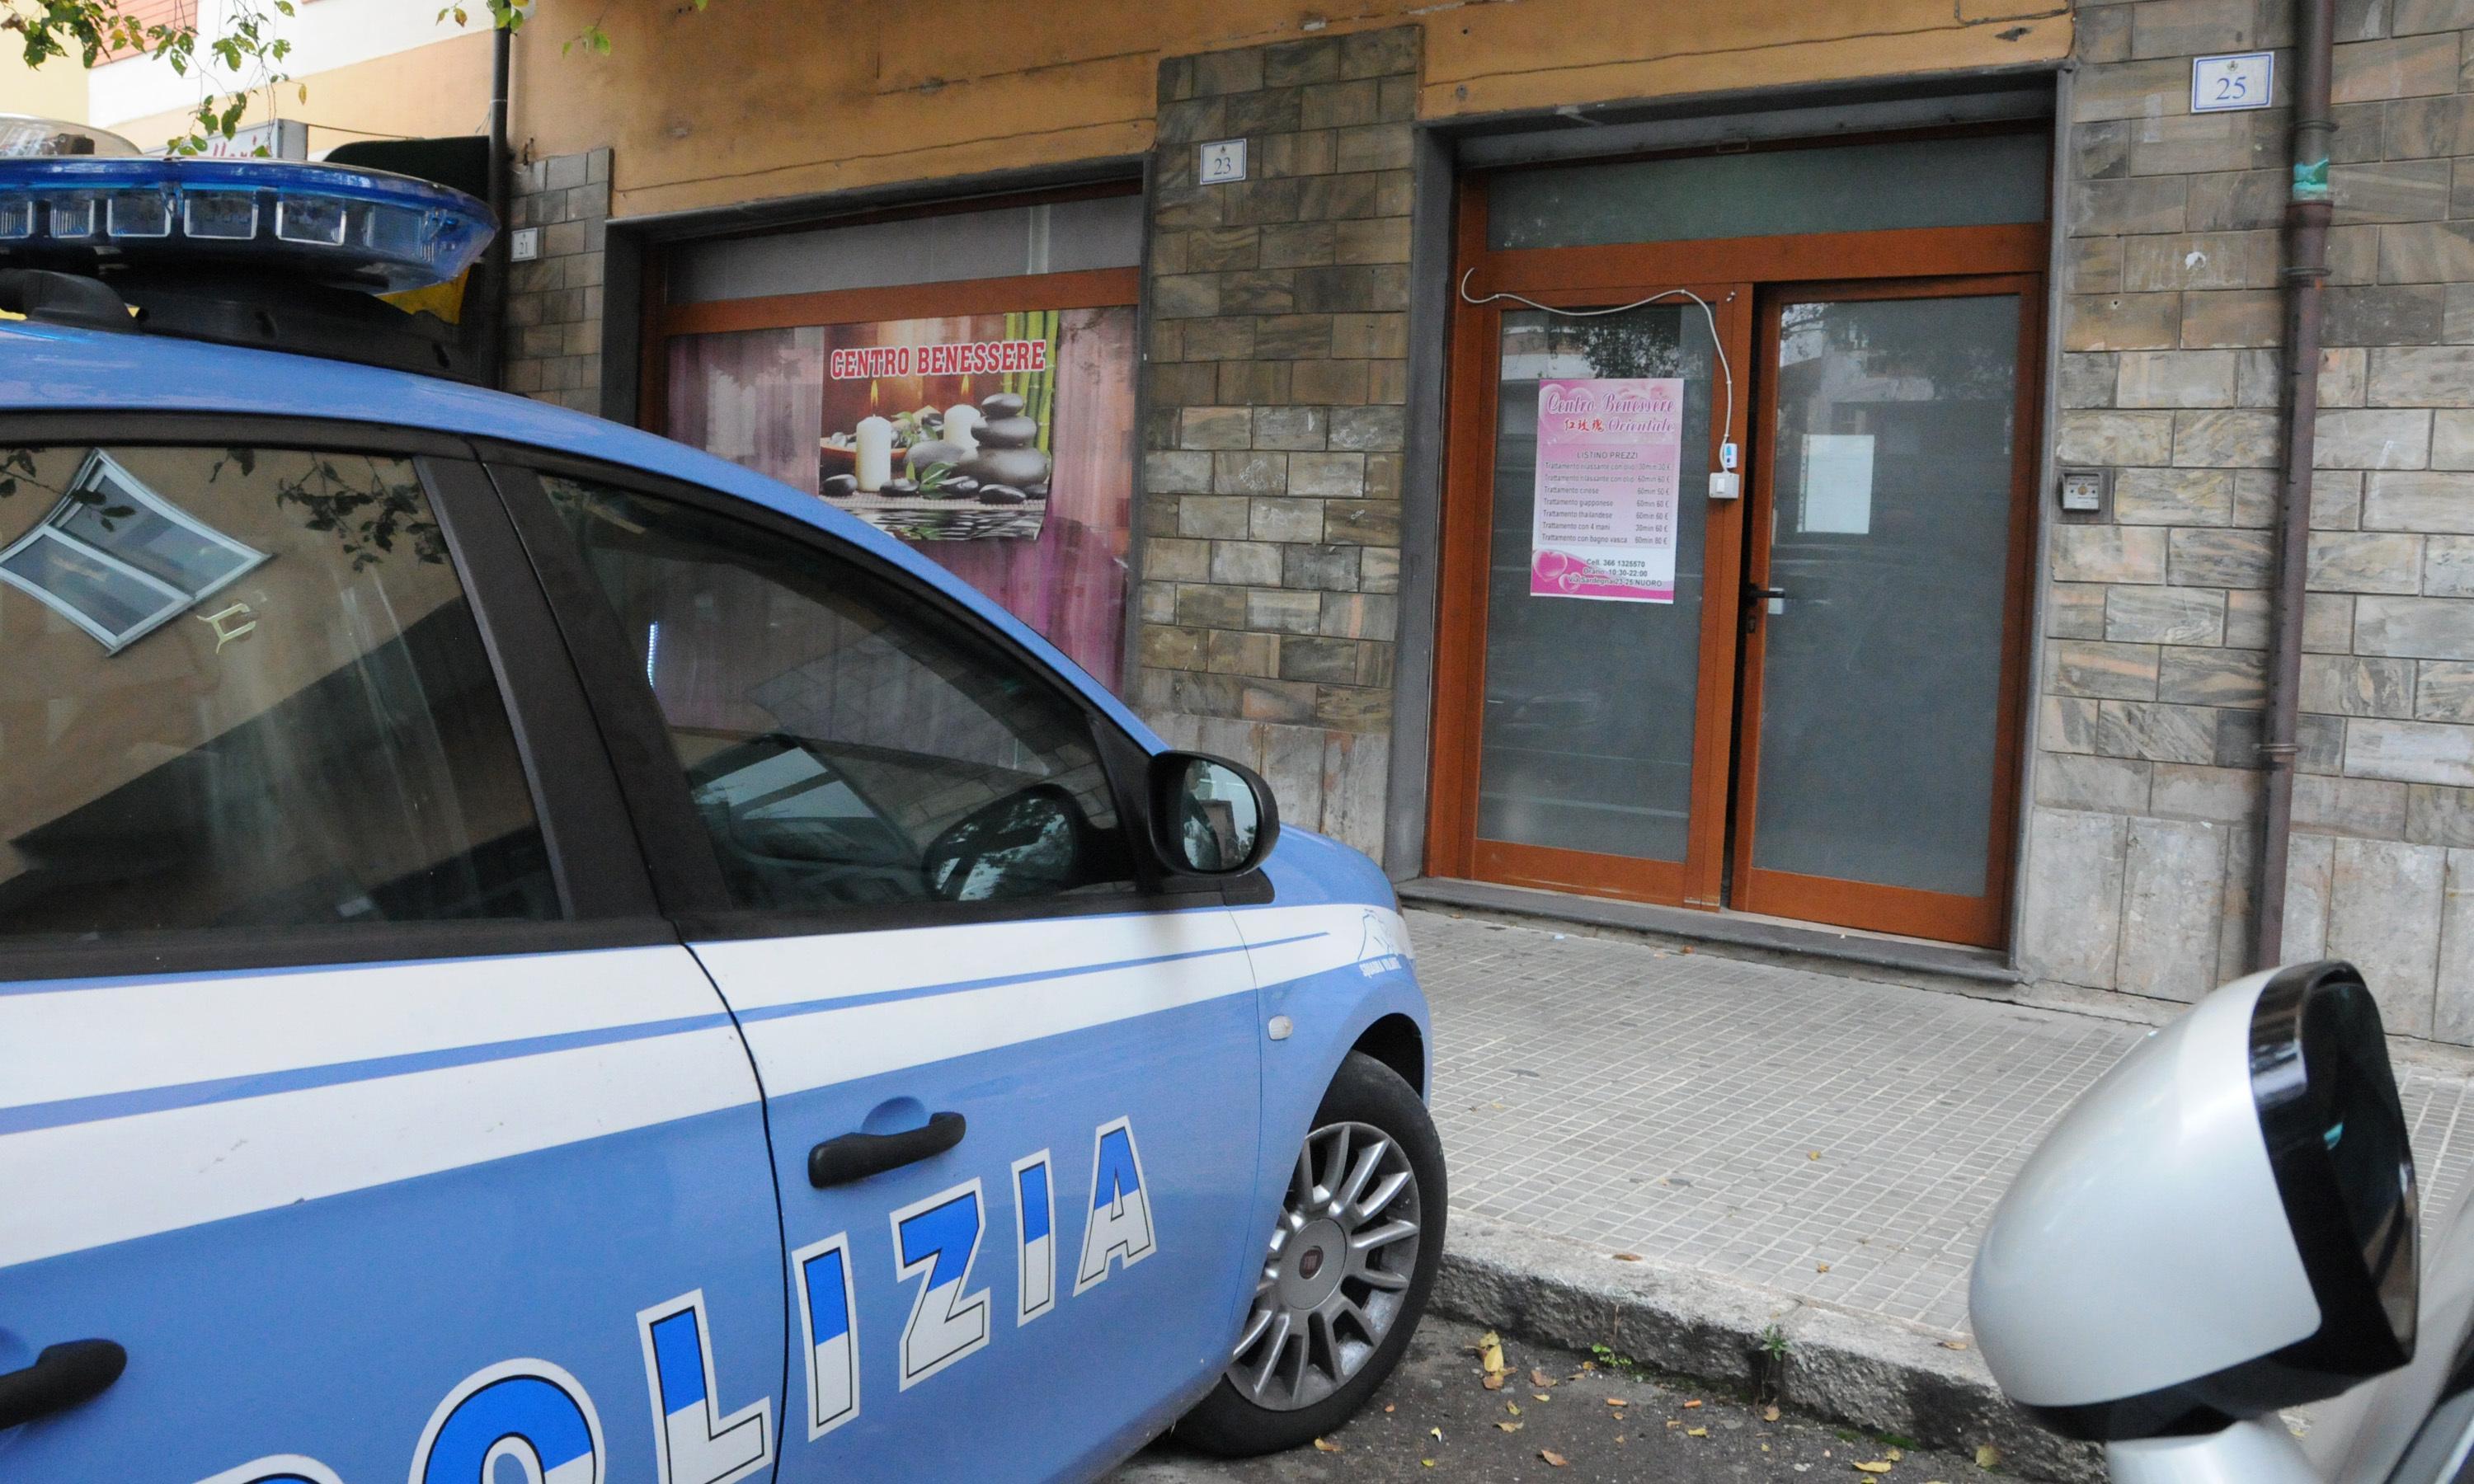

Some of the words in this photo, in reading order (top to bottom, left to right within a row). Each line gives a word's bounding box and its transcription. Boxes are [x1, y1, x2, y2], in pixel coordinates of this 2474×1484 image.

[2215, 76, 2246, 100] 25
[1213, 157, 1231, 176] 23
[831, 347, 910, 379] CENTRO
[916, 340, 1046, 375] BENESSERE
[1548, 392, 1595, 413] Centro
[1602, 392, 1675, 413] Benessere
[1608, 417, 1676, 433] Orientale
[1577, 451, 1608, 459] LISTINO
[1610, 451, 1638, 459] PREZZI
[1545, 462, 1580, 470] Trattamento
[1544, 474, 1579, 482] Trattamento
[1544, 486, 1578, 494] Trattamento
[1544, 497, 1578, 505] Trattamento
[1579, 500, 1614, 508] giapponese
[1543, 510, 1578, 518] Trattamento
[1542, 521, 1577, 529] Trattamento
[1542, 533, 1577, 542] Trattamento
[1589, 535, 1609, 544] bagno
[1634, 579, 1663, 587] NUORO
[191, 1115, 1156, 1484] OLIZIA
